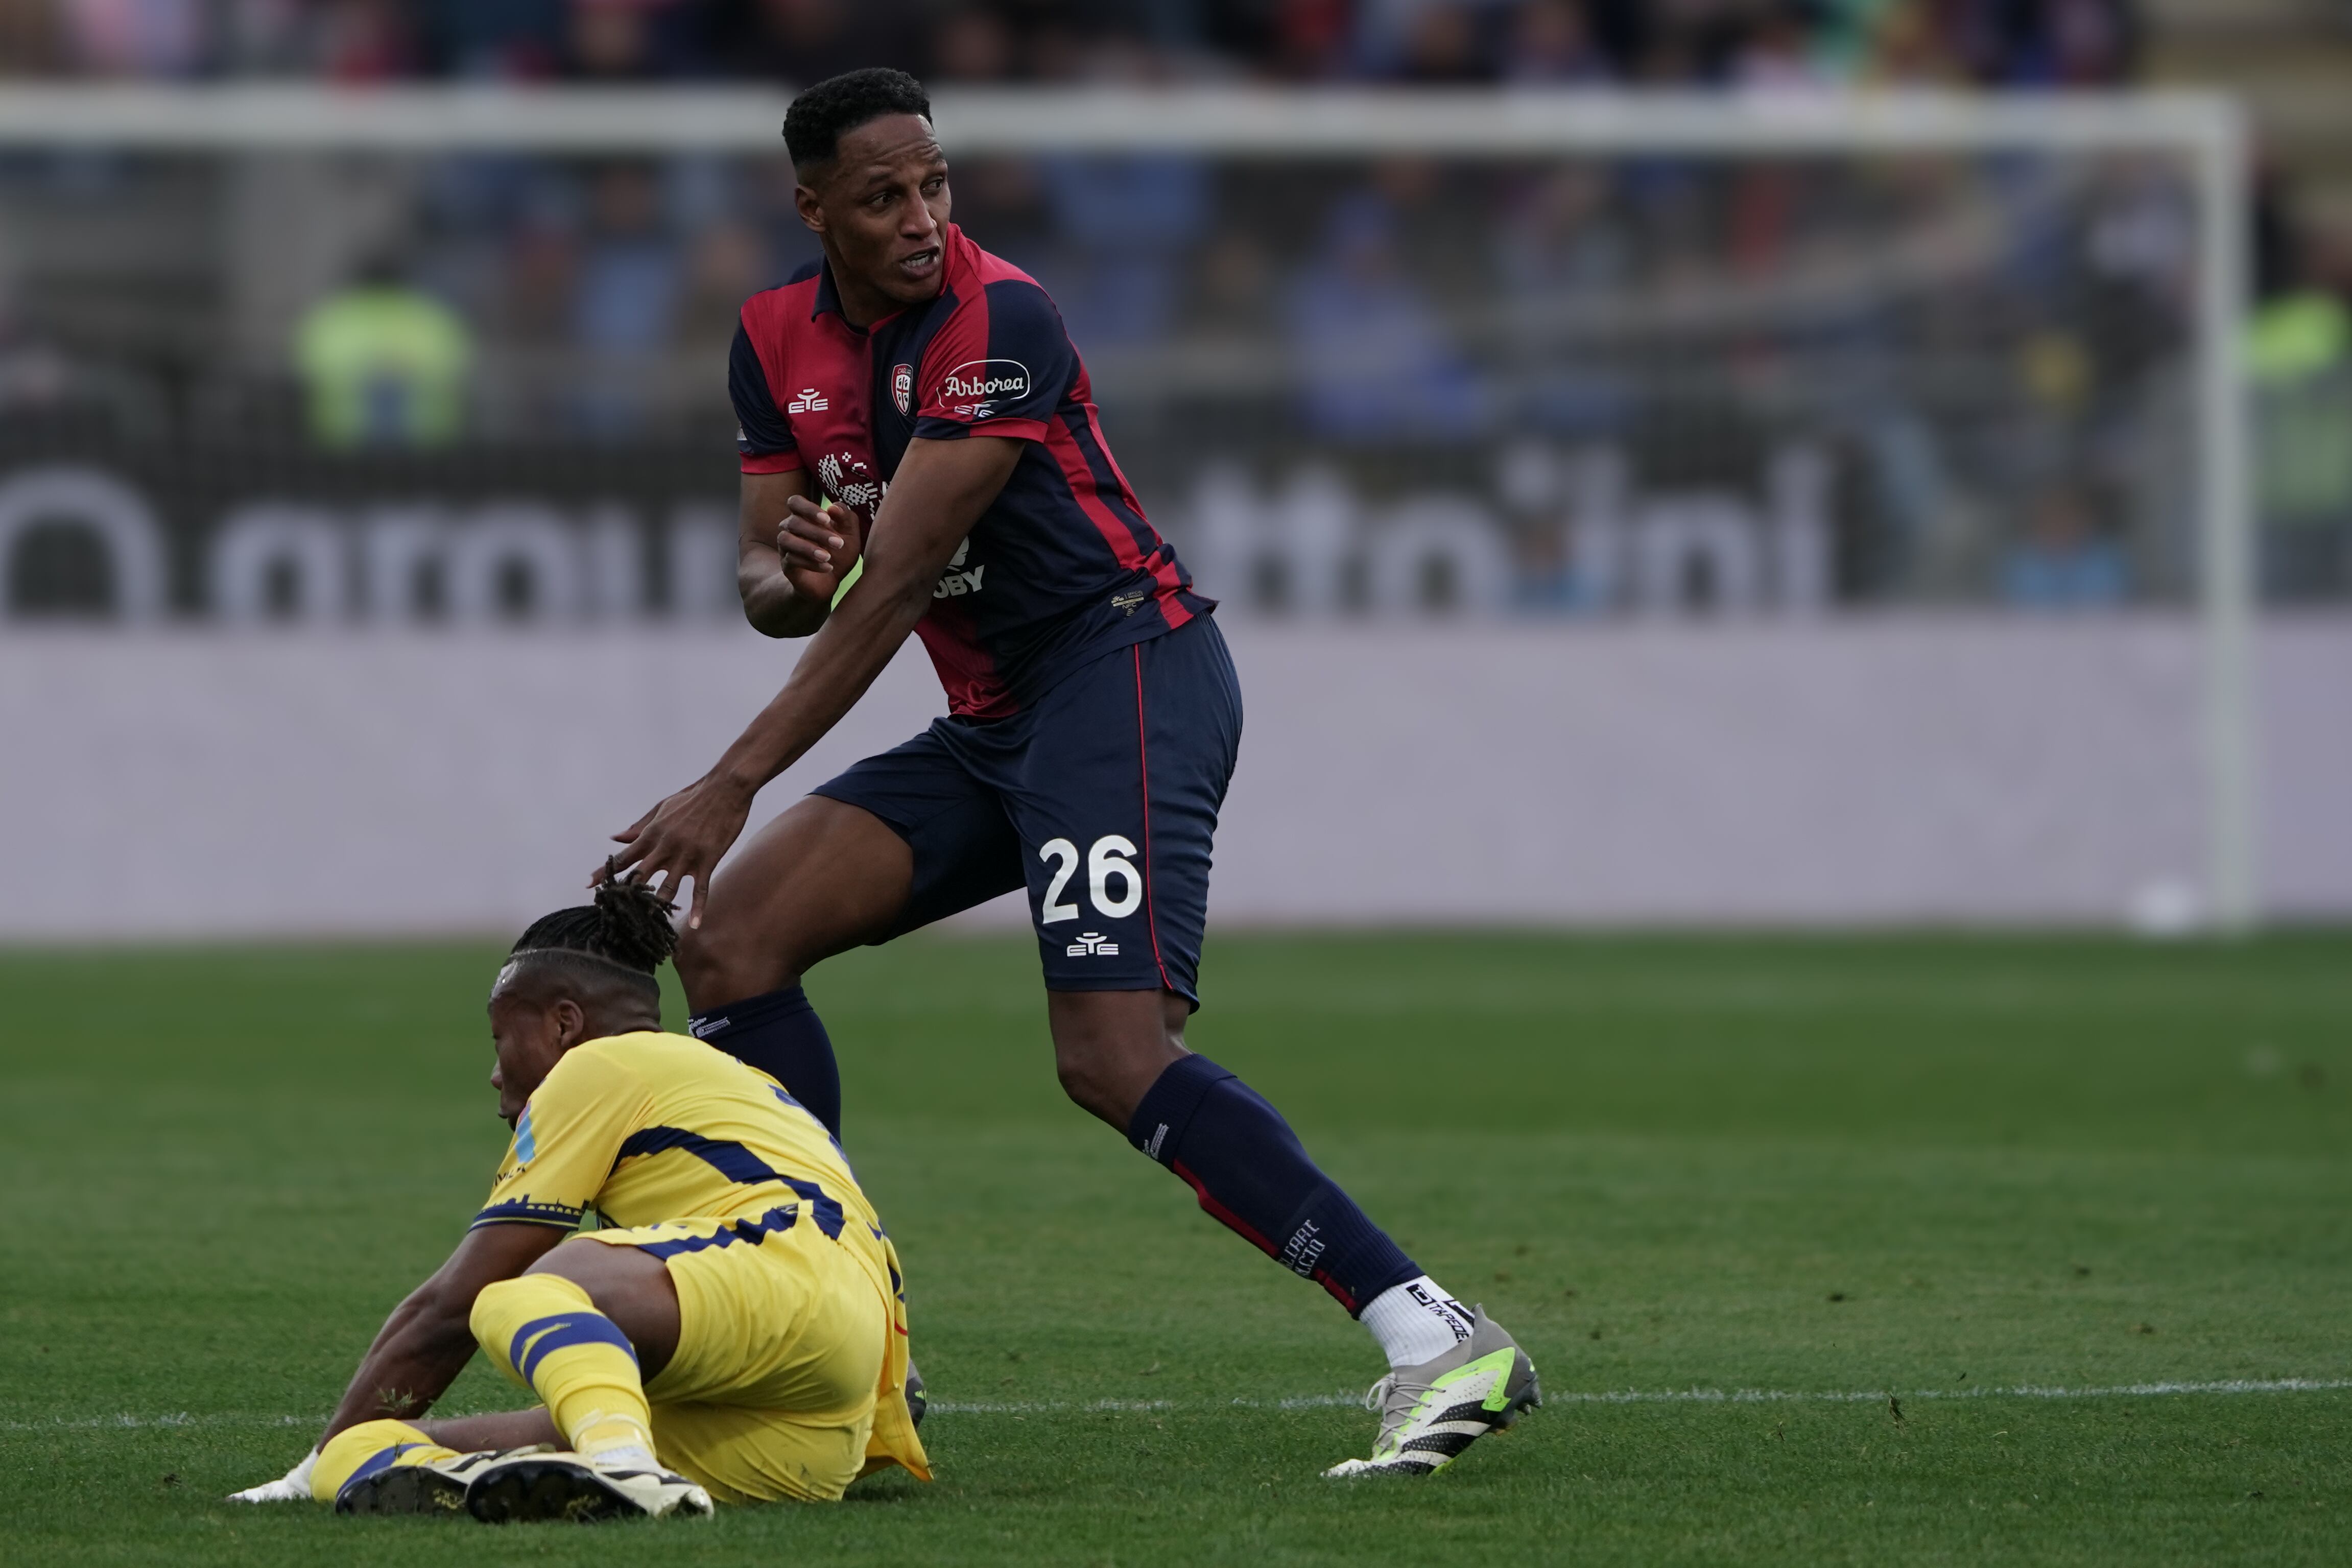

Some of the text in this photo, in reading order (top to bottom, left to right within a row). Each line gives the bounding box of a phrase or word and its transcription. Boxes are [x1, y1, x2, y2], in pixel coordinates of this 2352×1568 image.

[945, 376, 1025, 397] Arborea
[933, 564, 985, 599] OBY
[1039, 835, 1142, 924] 26
[1295, 1239, 1326, 1276] LCIO
